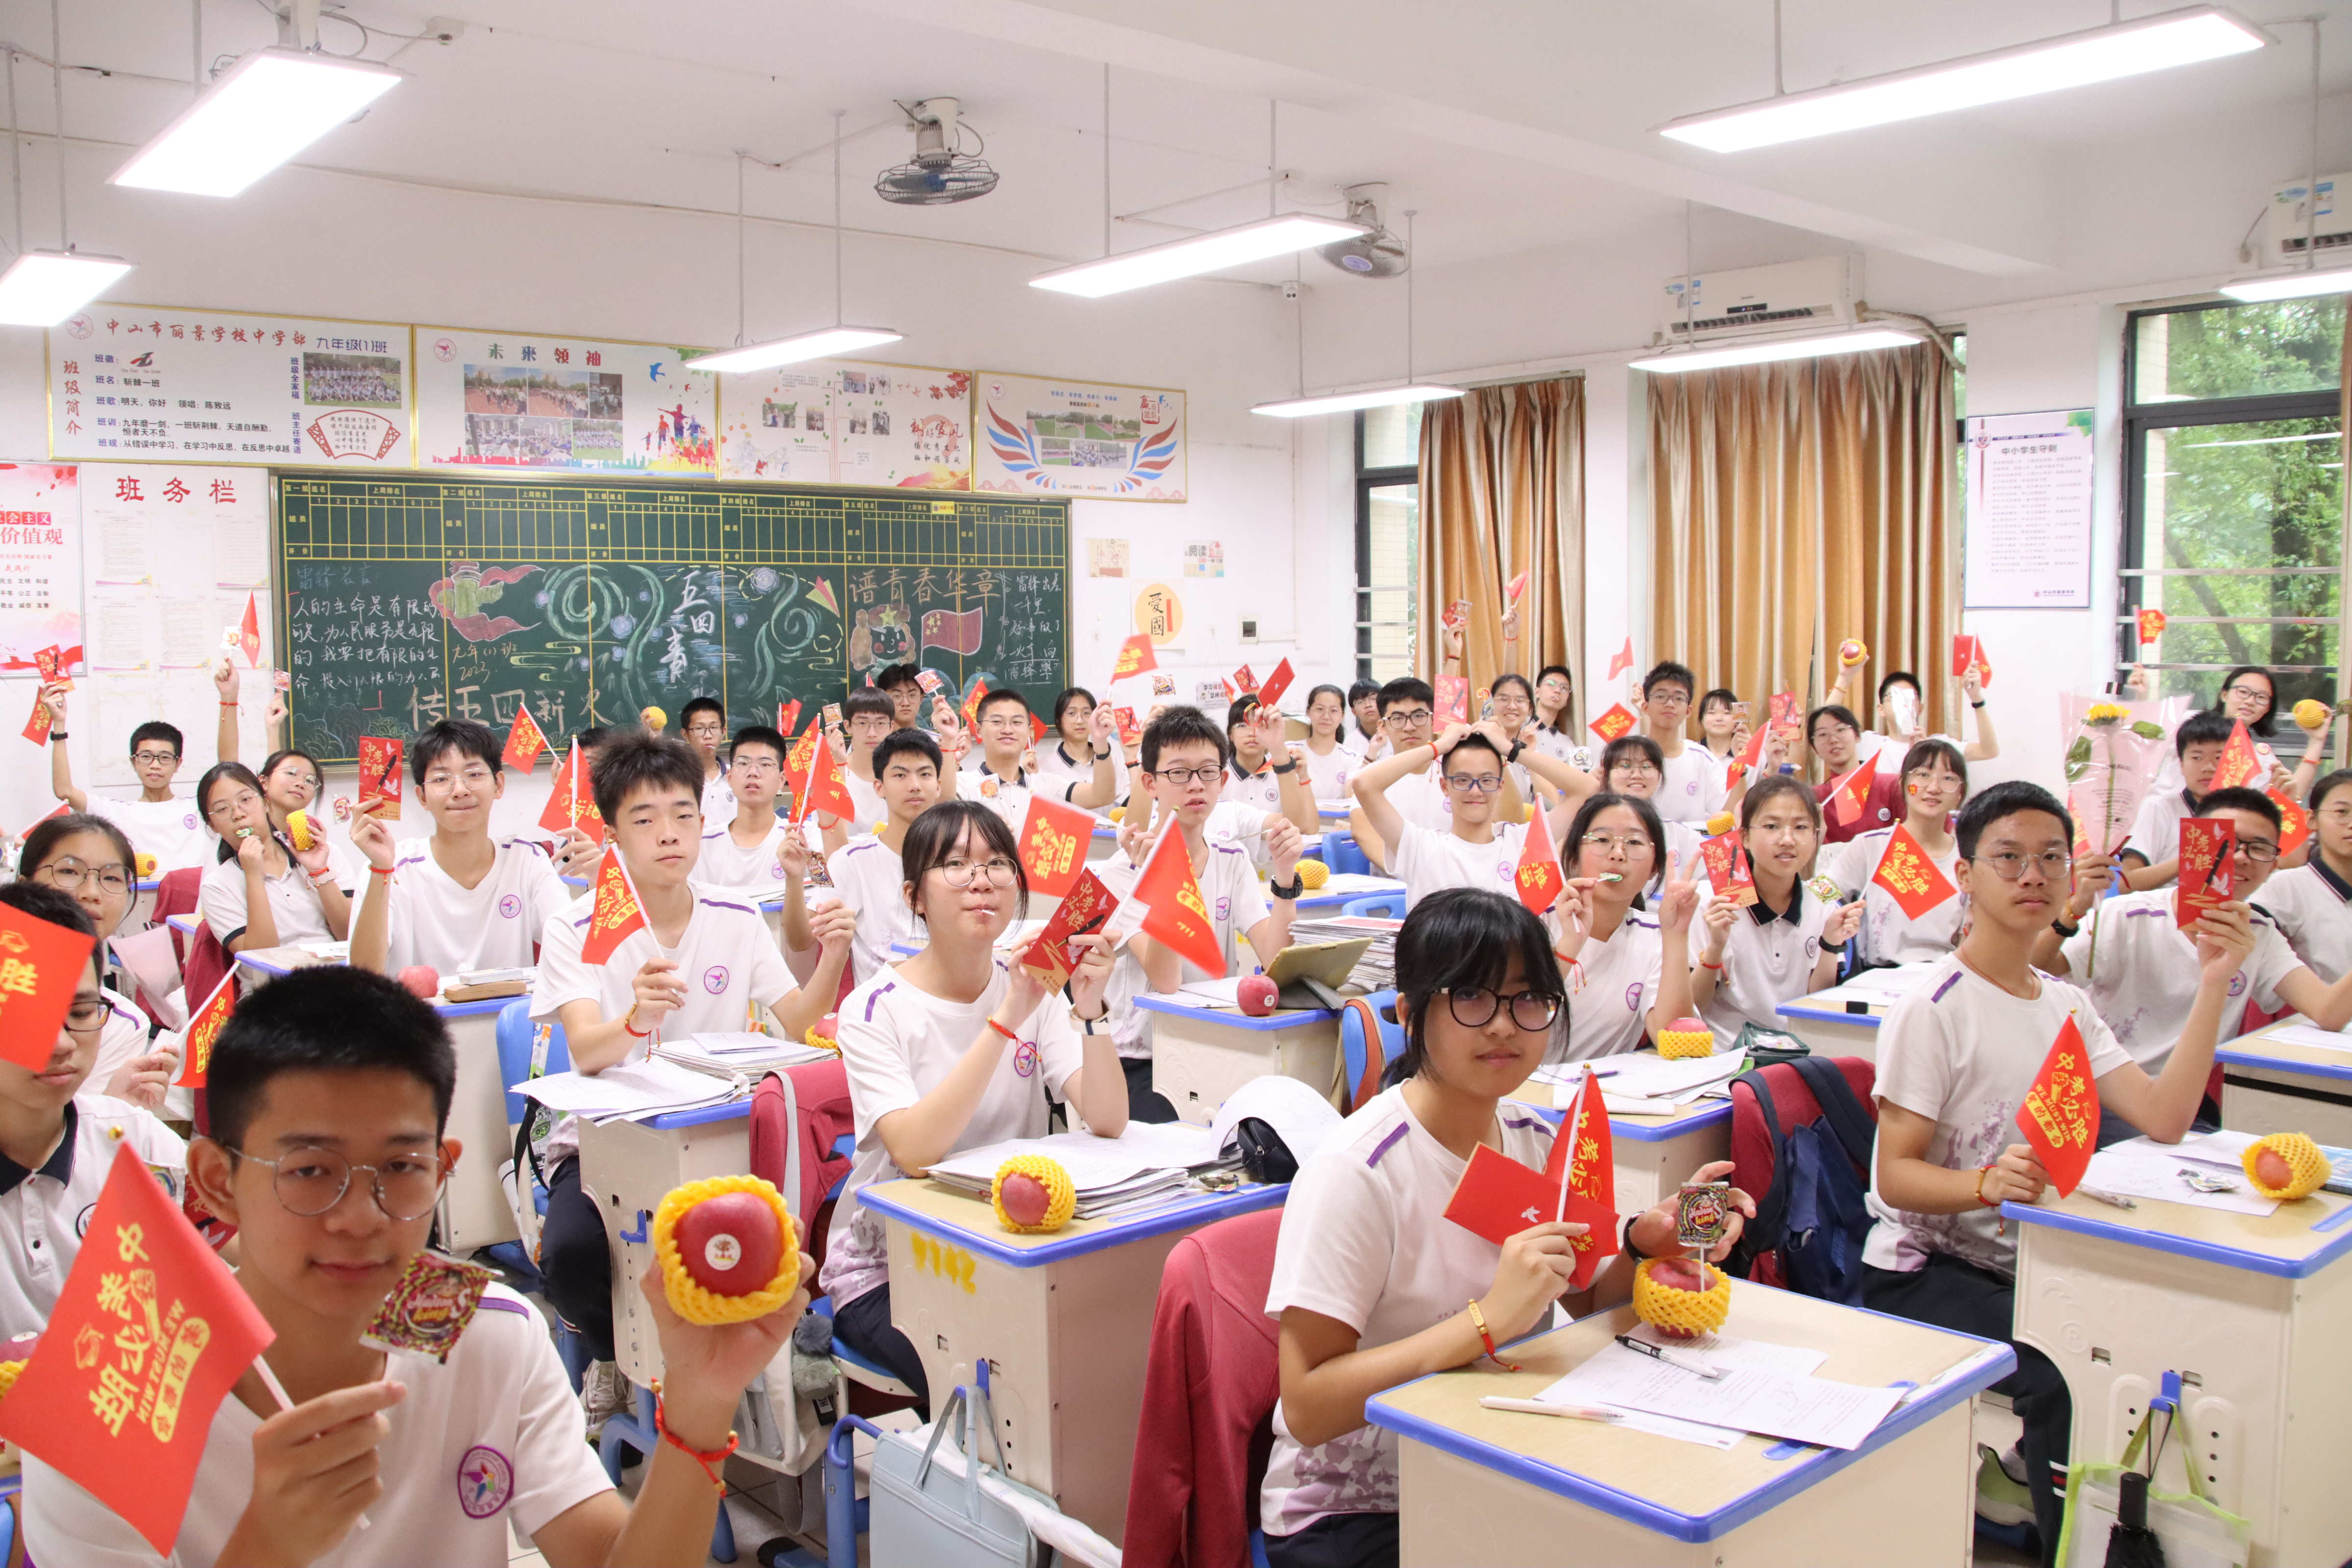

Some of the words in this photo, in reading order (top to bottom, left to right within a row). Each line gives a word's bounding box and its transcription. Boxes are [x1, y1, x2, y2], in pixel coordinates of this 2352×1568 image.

[106, 318, 306, 347] 中山市丽景学校中学部
[317, 337, 388, 353] 九年级(1)班
[64, 360, 82, 436] 班级简介
[123, 378, 161, 388] 斩棘一班
[291, 357, 300, 399] 班级全家福
[292, 412, 301, 454] 班主任寄语
[2001, 444, 2058, 456] 中小学生守则
[115, 475, 237, 504] 班务栏
[0, 527, 63, 545] 价值观
[850, 566, 1001, 616] 谱青春华章
[1148, 592, 1165, 636] 愛國
[360, 741, 385, 777] 中考必胜
[1706, 844, 1732, 873] 中考必胜
[2181, 824, 2214, 872] 中考必胜
[1064, 880, 1095, 931] 中考必胜
[2035, 1083, 2048, 1098] WE
[2044, 1097, 2063, 1122] MUST
[2059, 1122, 2073, 1142] WIN
[2055, 1052, 2089, 1150] 中考必胜
